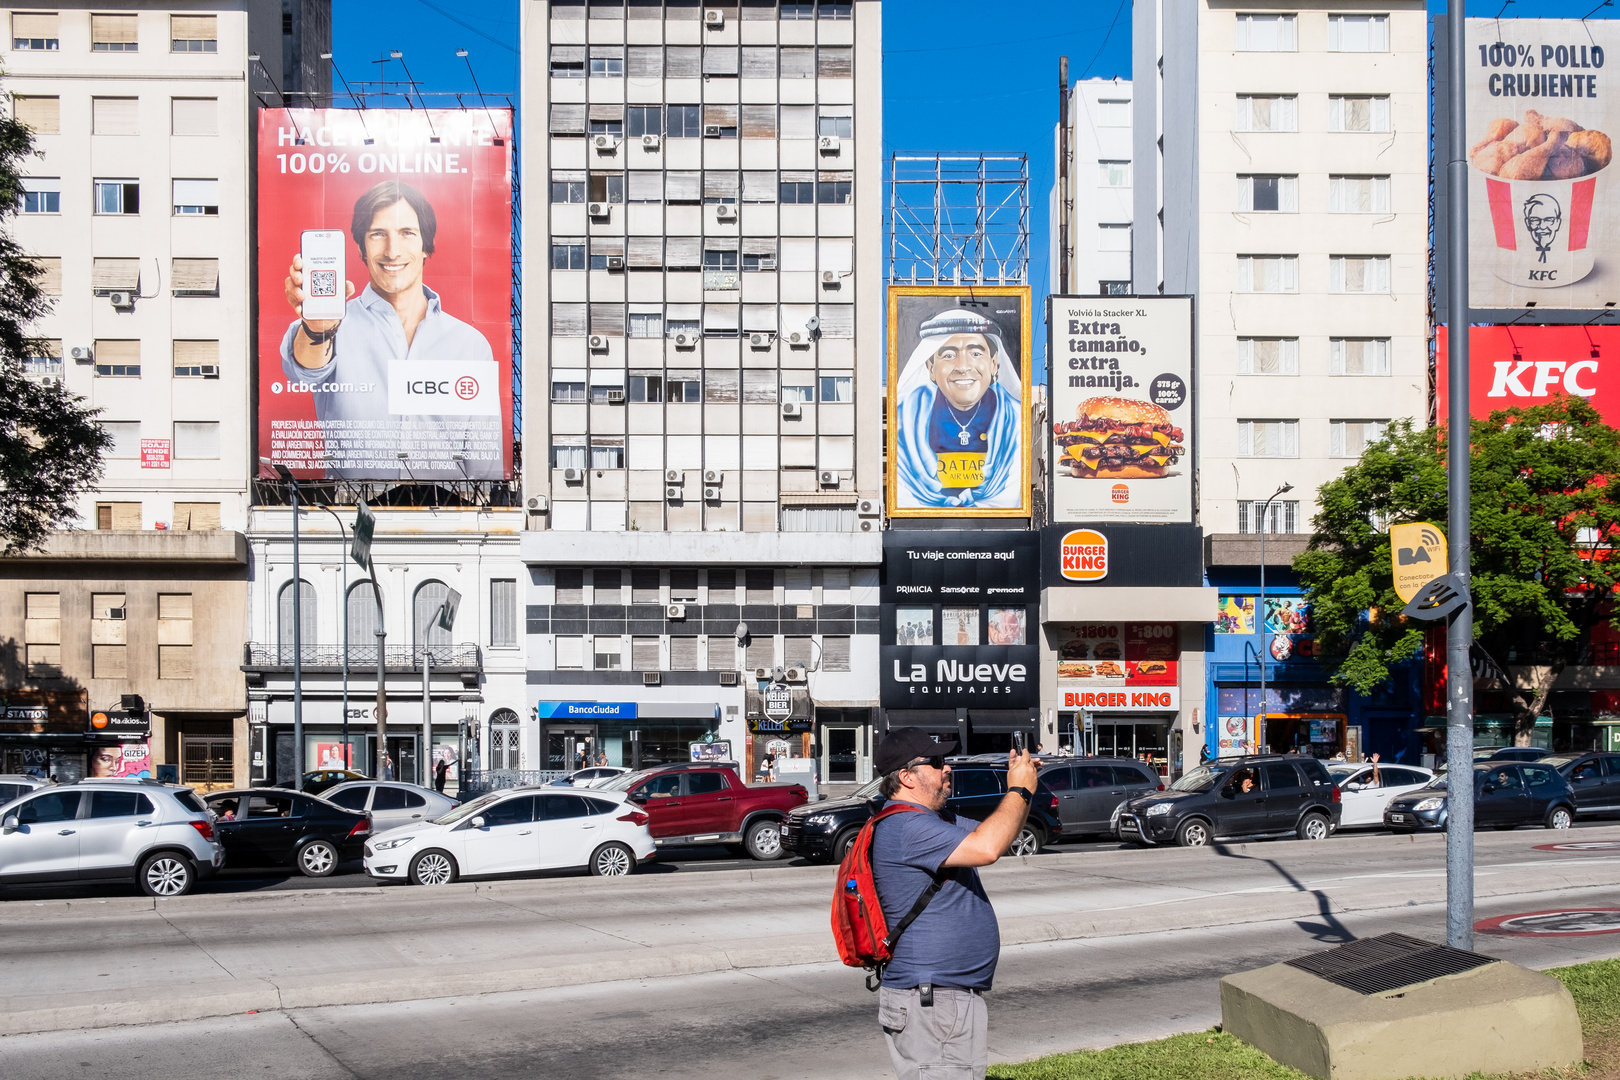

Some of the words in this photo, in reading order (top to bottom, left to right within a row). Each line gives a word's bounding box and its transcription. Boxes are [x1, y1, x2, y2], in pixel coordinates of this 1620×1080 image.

[1478, 44, 1534, 68] 100%
[1541, 44, 1604, 68] POLLO
[1488, 74, 1597, 98] CRUJIENTE
[276, 153, 350, 173] 100%
[358, 153, 468, 173] ONLINE.
[1528, 270, 1557, 281] KFC
[1069, 320, 1121, 334] Extra
[1069, 335, 1146, 355] tamaño,
[1069, 356, 1119, 370] extra
[1069, 370, 1140, 392] manija.
[1488, 361, 1598, 397] KFC
[286, 381, 376, 393] icbc.com.ar
[407, 381, 449, 394] ICBC
[937, 460, 985, 474] QATAR
[907, 551, 920, 559] Tu
[922, 550, 944, 561] viaje
[946, 551, 992, 559] comienza
[994, 550, 1014, 560] aquí
[1063, 546, 1105, 555] BURGER
[1063, 556, 1106, 569] KING
[896, 586, 932, 594] PRIMICIA
[894, 660, 926, 682] La
[937, 660, 1026, 682] Nueve
[767, 692, 789, 701] KELLER
[1065, 692, 1127, 706] BURGER
[1132, 692, 1171, 706] KING
[7, 710, 48, 718] STATION
[345, 709, 368, 718] CBC
[568, 706, 619, 715] BancoCiudad
[758, 721, 784, 730] KELLER
